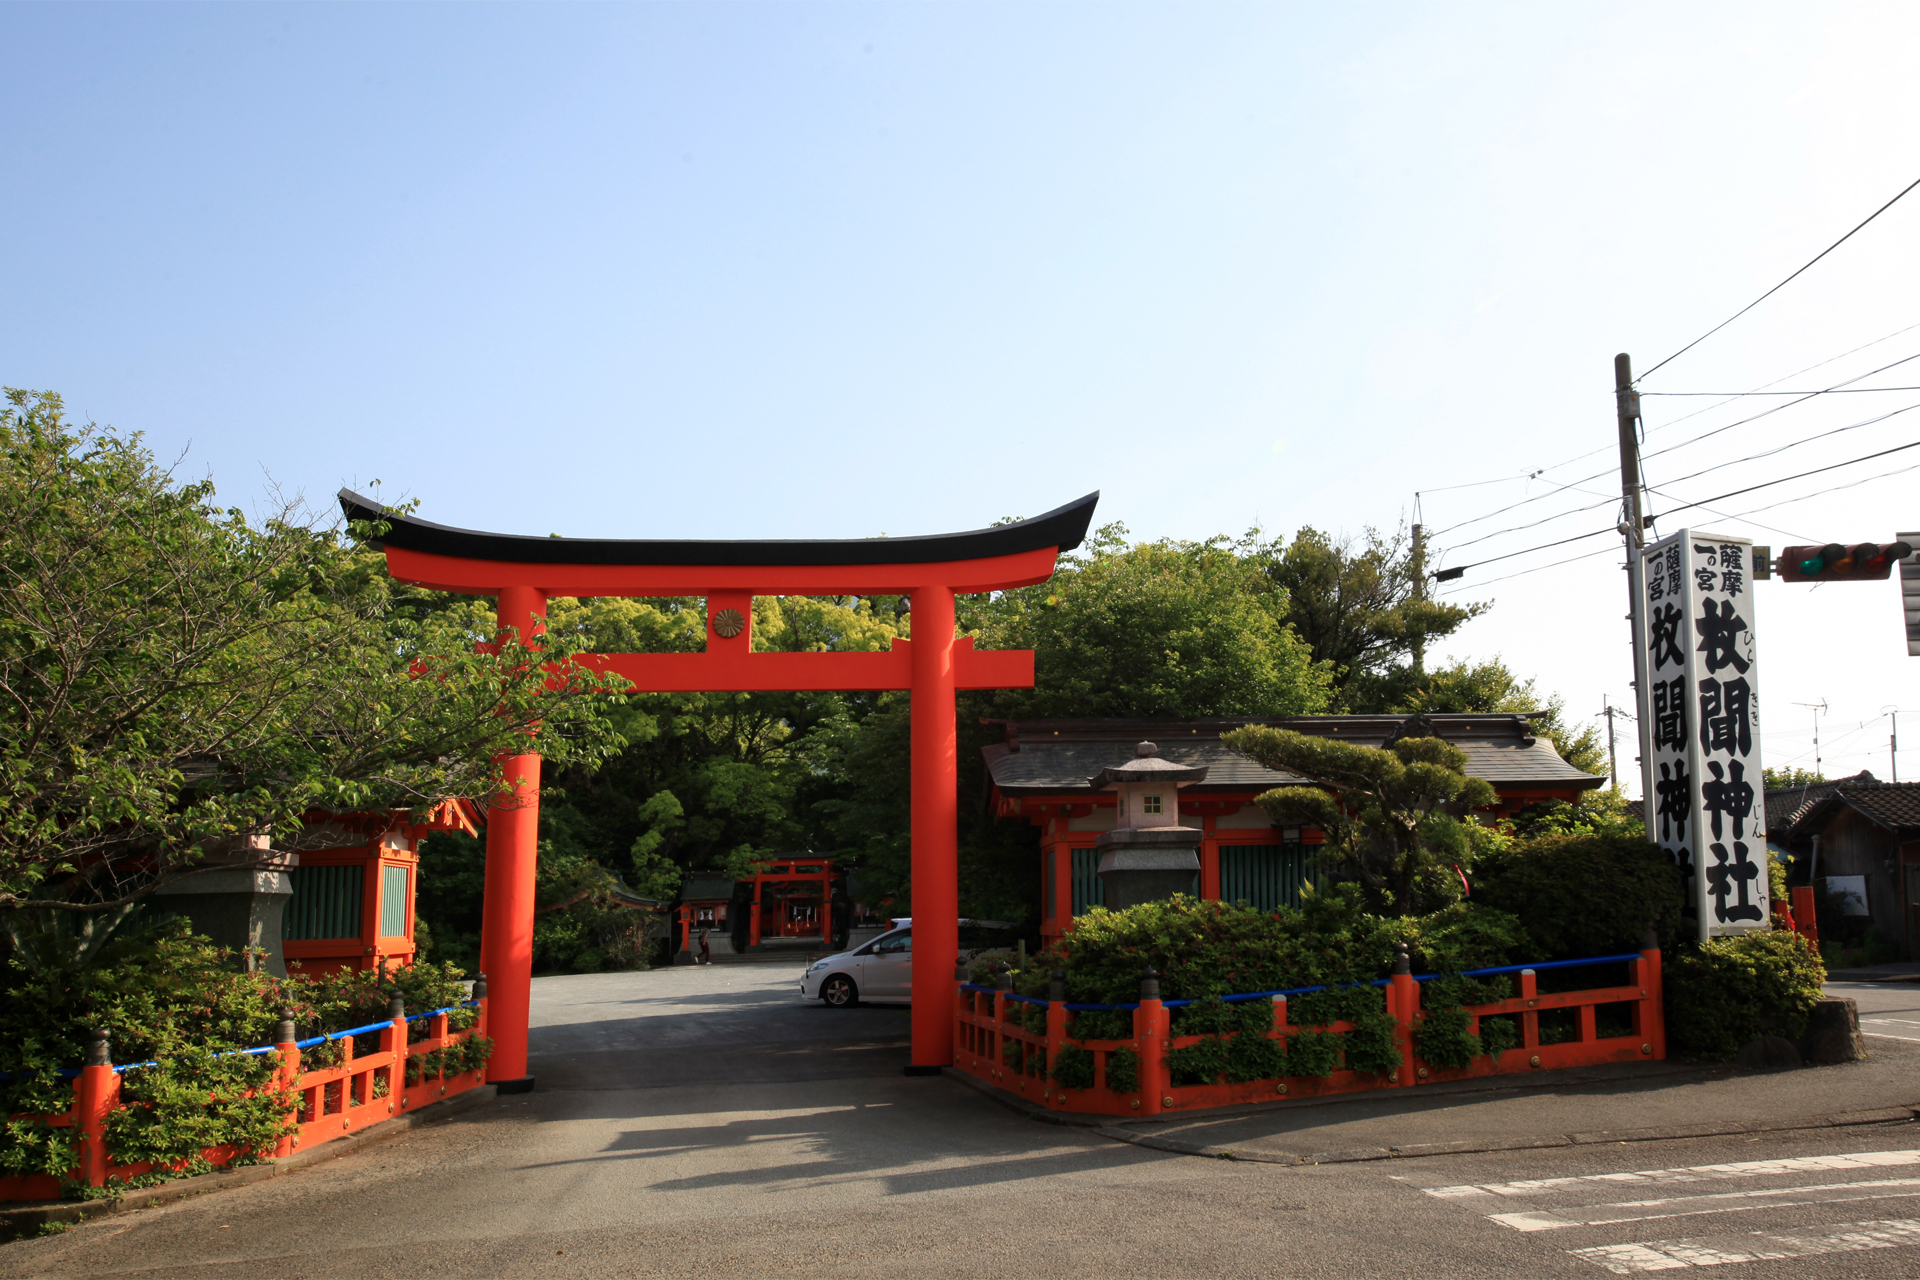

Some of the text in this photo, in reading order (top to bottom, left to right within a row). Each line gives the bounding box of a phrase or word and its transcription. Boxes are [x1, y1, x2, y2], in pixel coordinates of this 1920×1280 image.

[1648, 552, 1664, 602] 一の宮
[1694, 544, 1717, 592] 一の宮
[1719, 544, 1743, 598] 薩摩
[1743, 630, 1754, 664] ひら
[1750, 692, 1759, 727] きき
[1695, 597, 1763, 924] 枚聞神社
